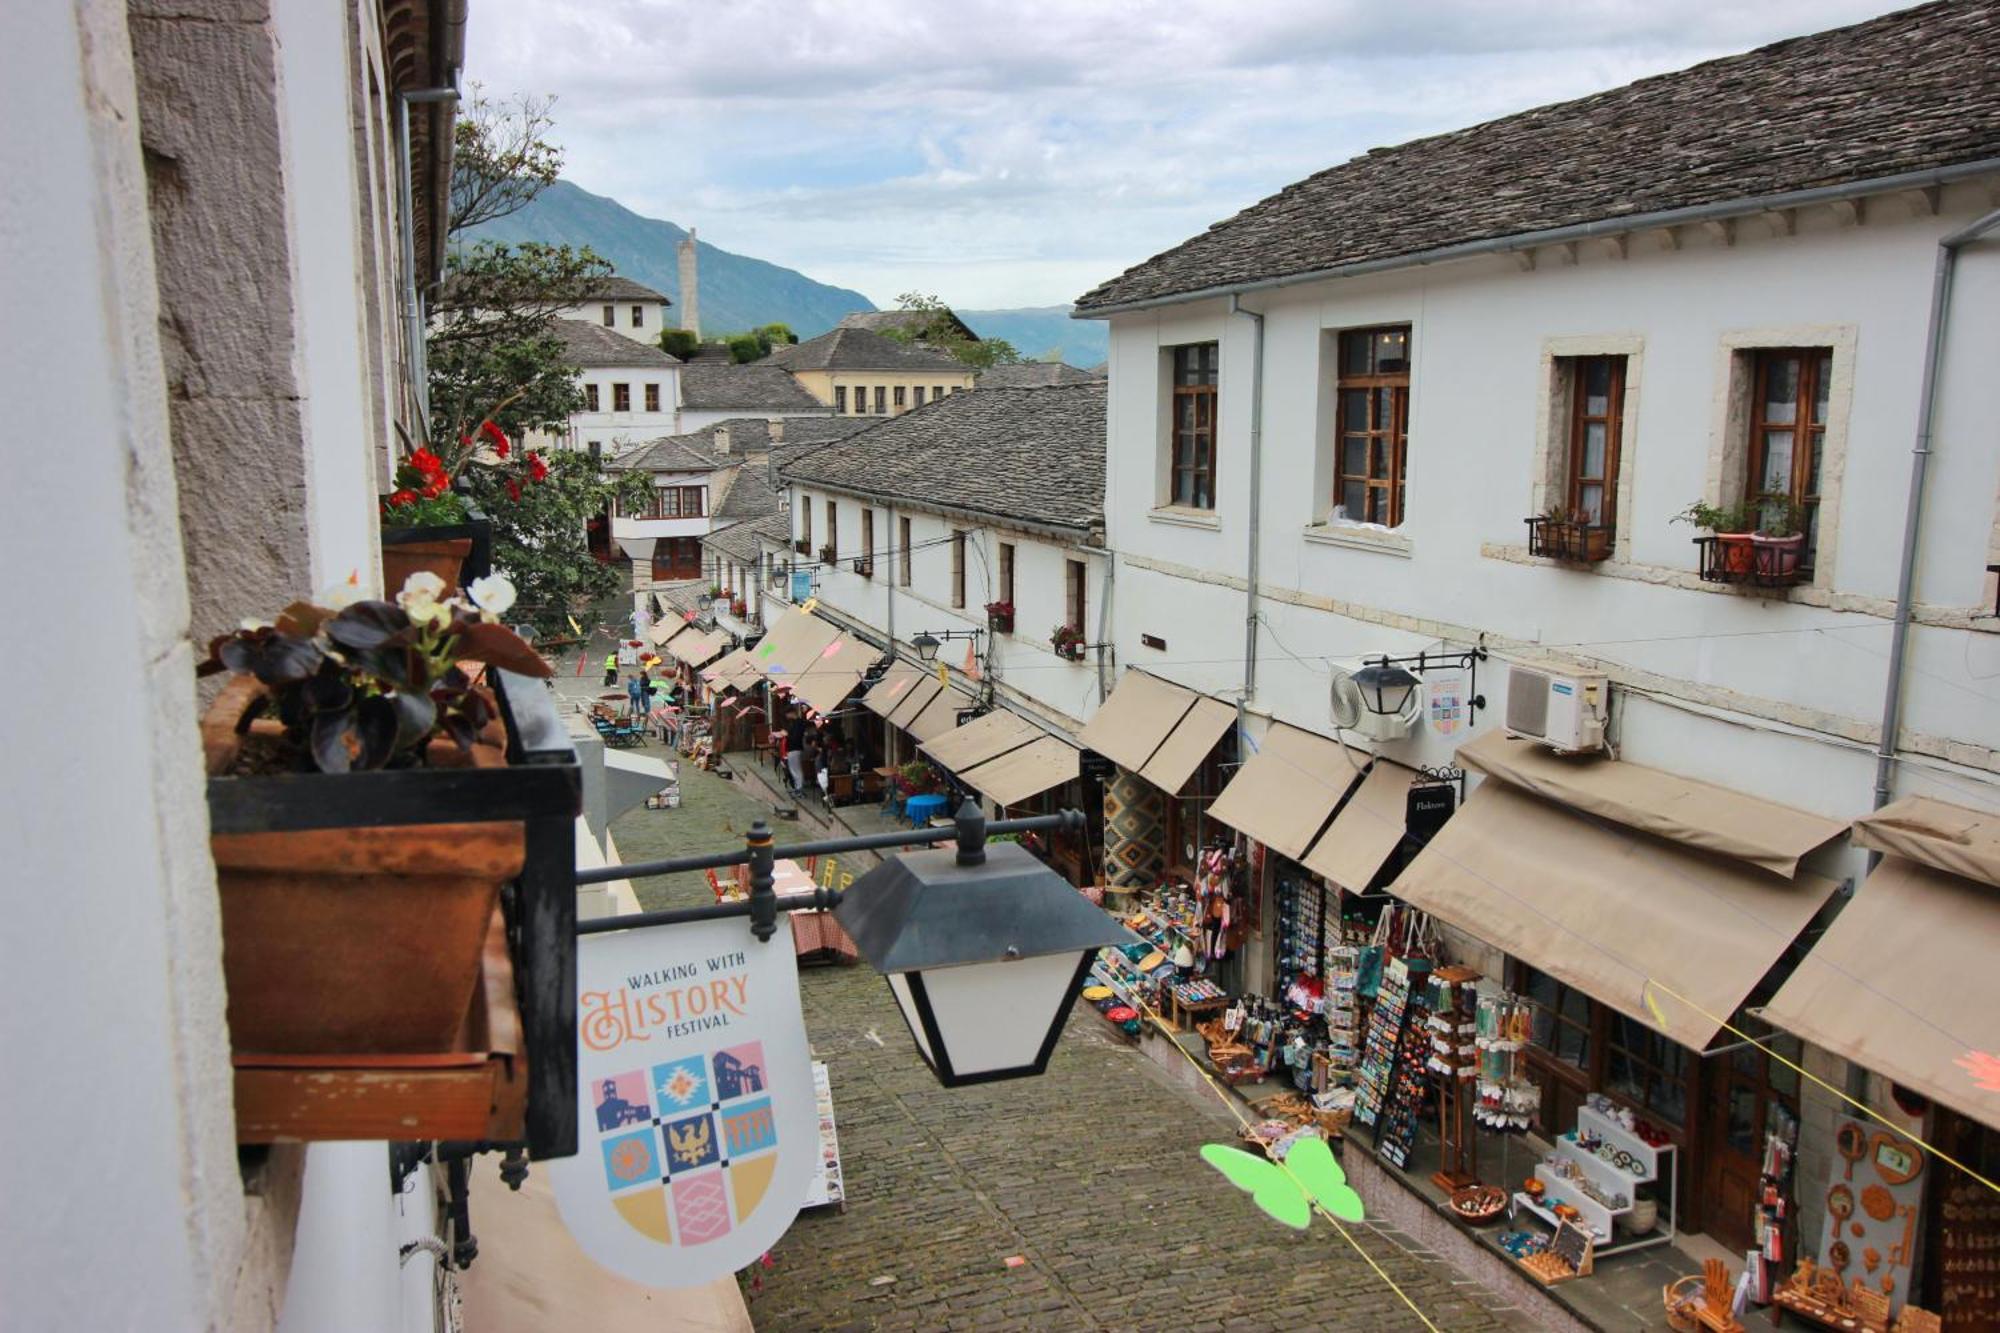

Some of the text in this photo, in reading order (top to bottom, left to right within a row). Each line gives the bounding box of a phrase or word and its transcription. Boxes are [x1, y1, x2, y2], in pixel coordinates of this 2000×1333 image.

[627, 952, 745, 989] WALKING WITH
[581, 974, 748, 1051] HISTORY
[667, 1014, 730, 1039] FESTIVAL
